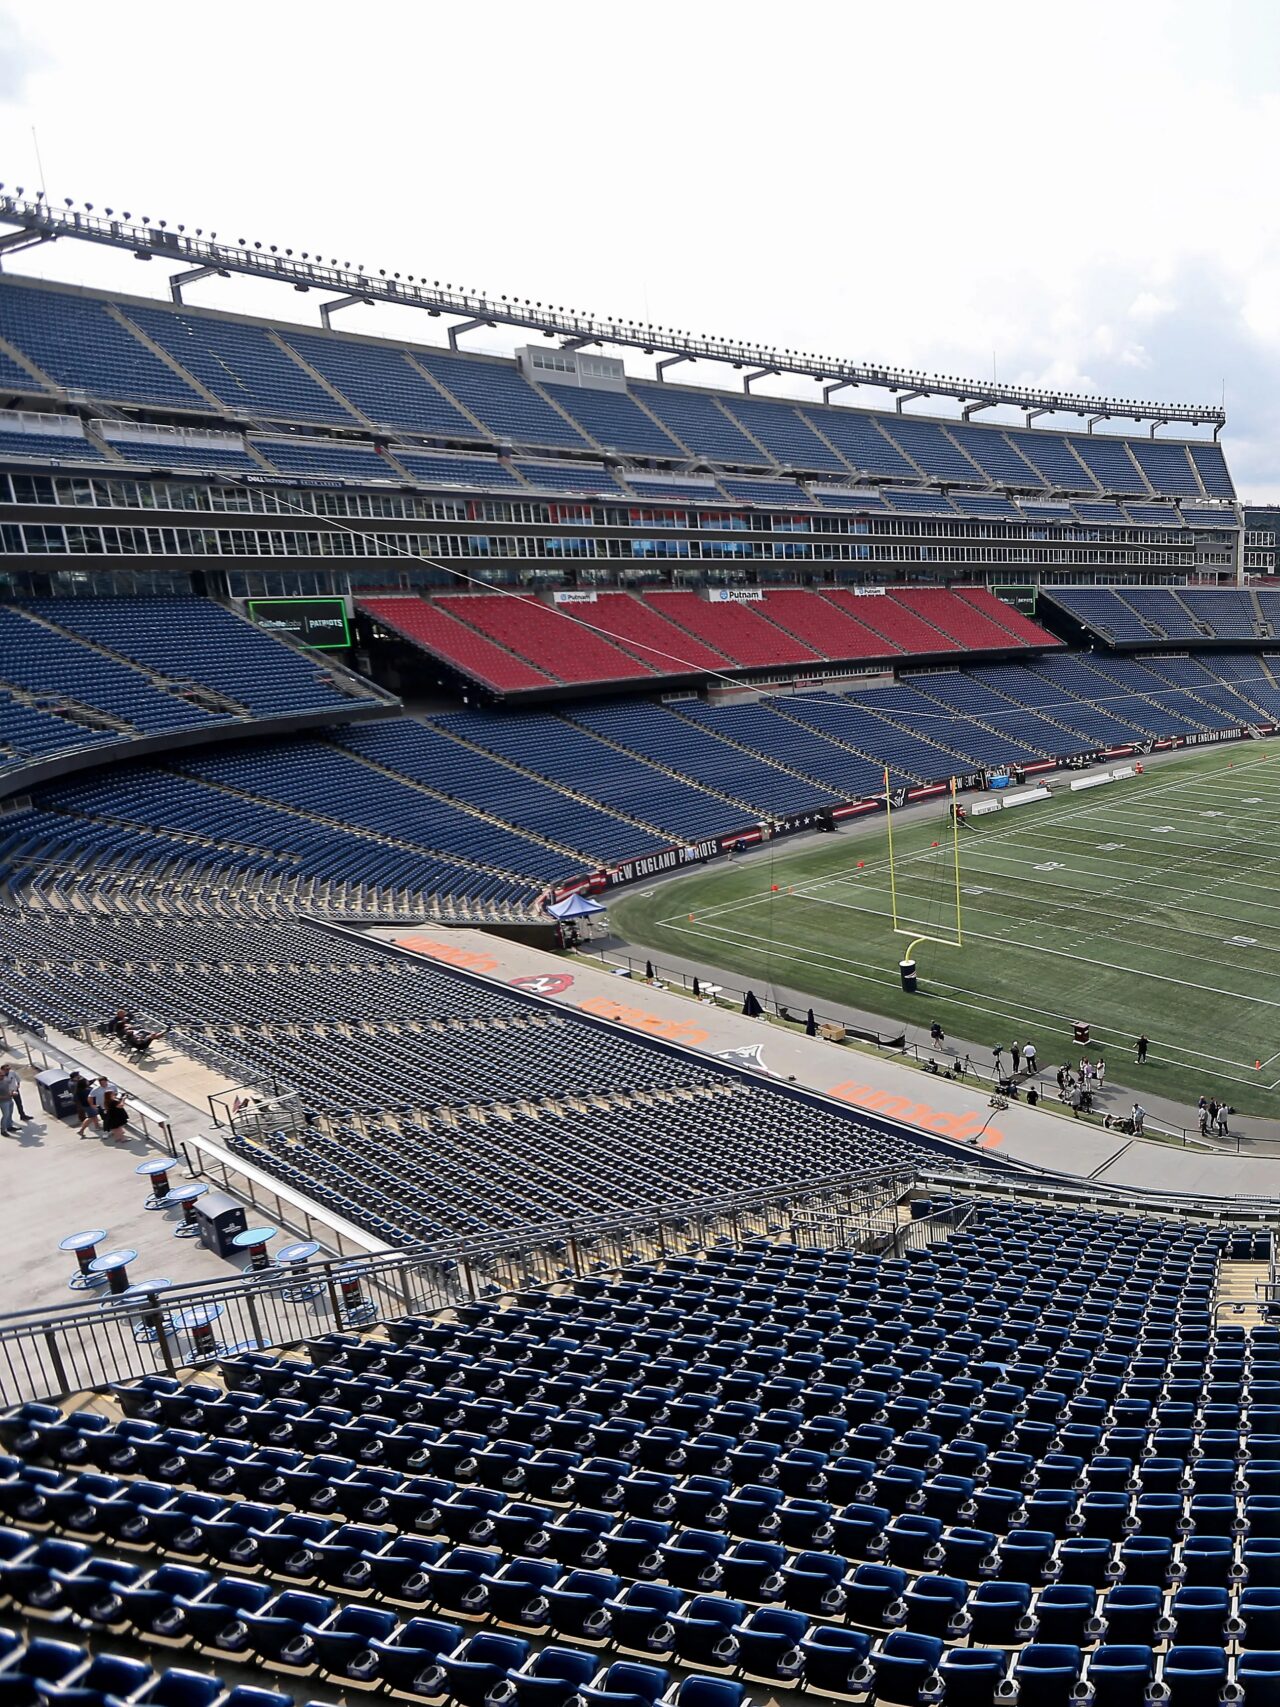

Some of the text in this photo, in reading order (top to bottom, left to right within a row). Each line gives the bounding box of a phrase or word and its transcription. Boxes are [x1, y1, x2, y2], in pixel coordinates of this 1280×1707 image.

[1186, 734, 1196, 744] NEW
[1220, 728, 1241, 740] PATRIOTS
[635, 851, 676, 876] ENGLAND
[1223, 935, 1258, 948] 10
